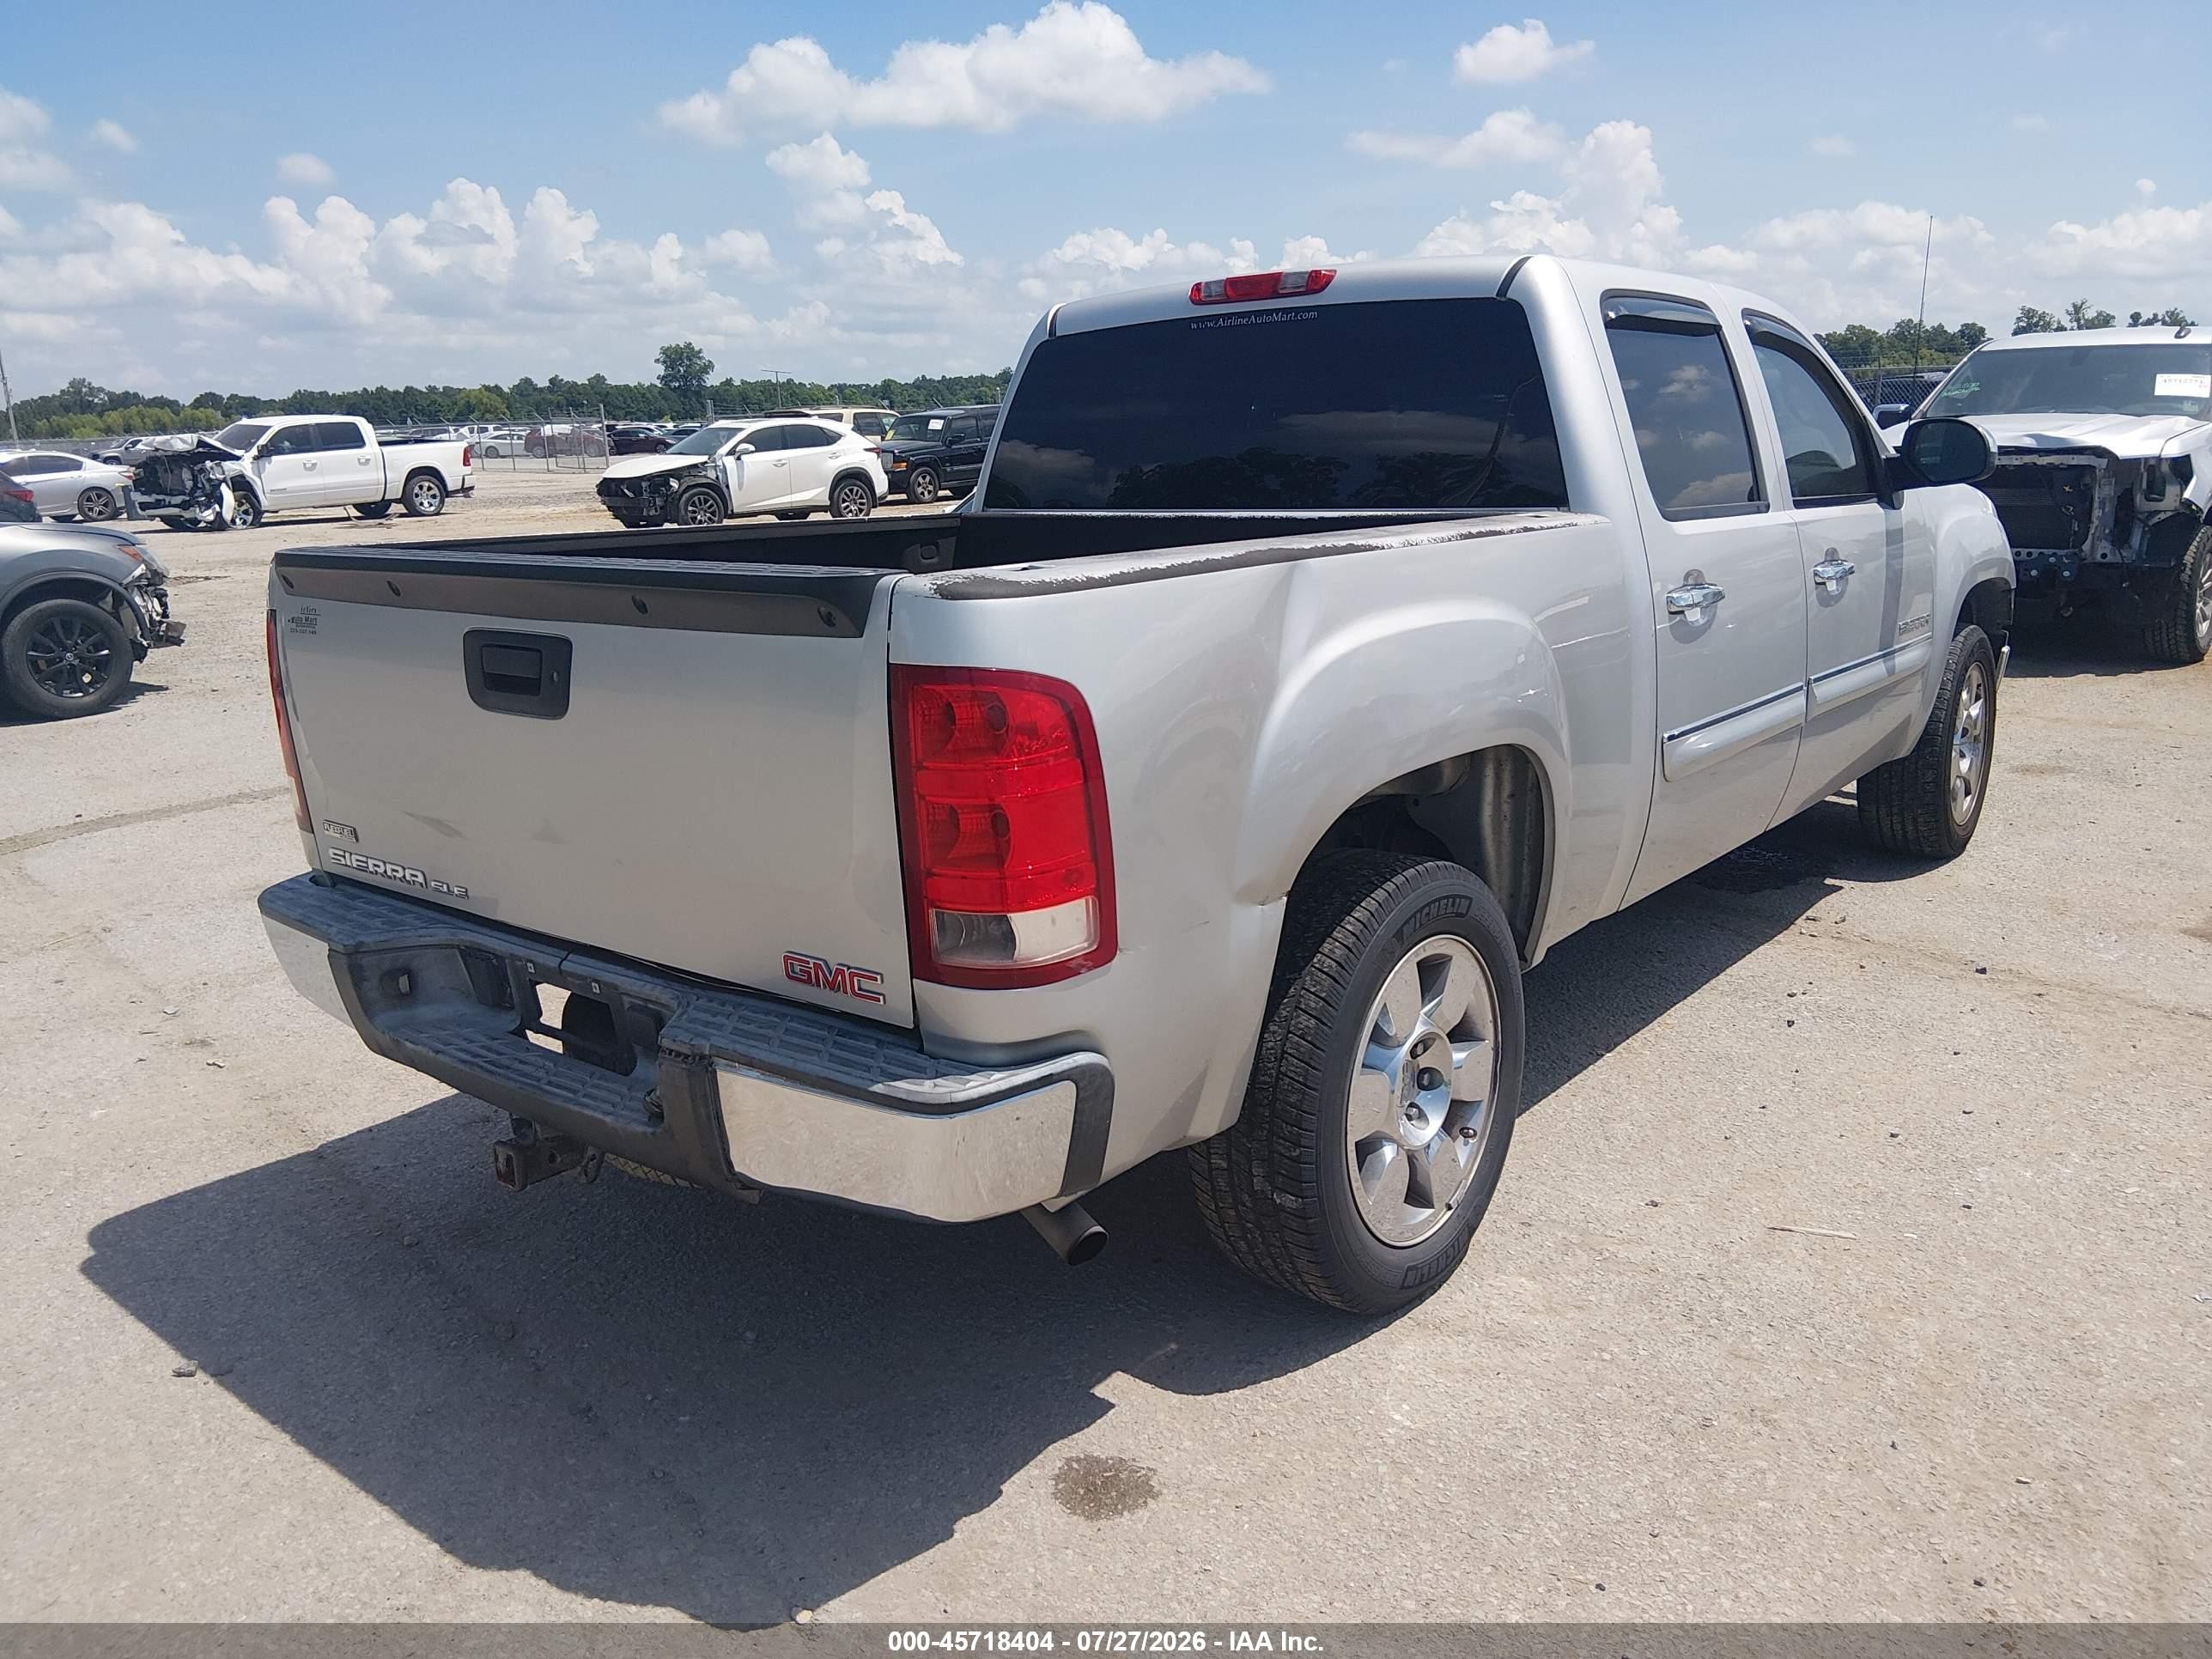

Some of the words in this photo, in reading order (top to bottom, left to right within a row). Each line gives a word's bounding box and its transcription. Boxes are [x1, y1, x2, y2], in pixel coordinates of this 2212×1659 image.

[1189, 310, 1318, 330] www.AirlineAutoMart.com
[329, 847, 427, 889] SIERRA
[431, 879, 469, 900] SLE
[1402, 897, 1471, 943] MICHELIN
[782, 951, 886, 1006] GMC
